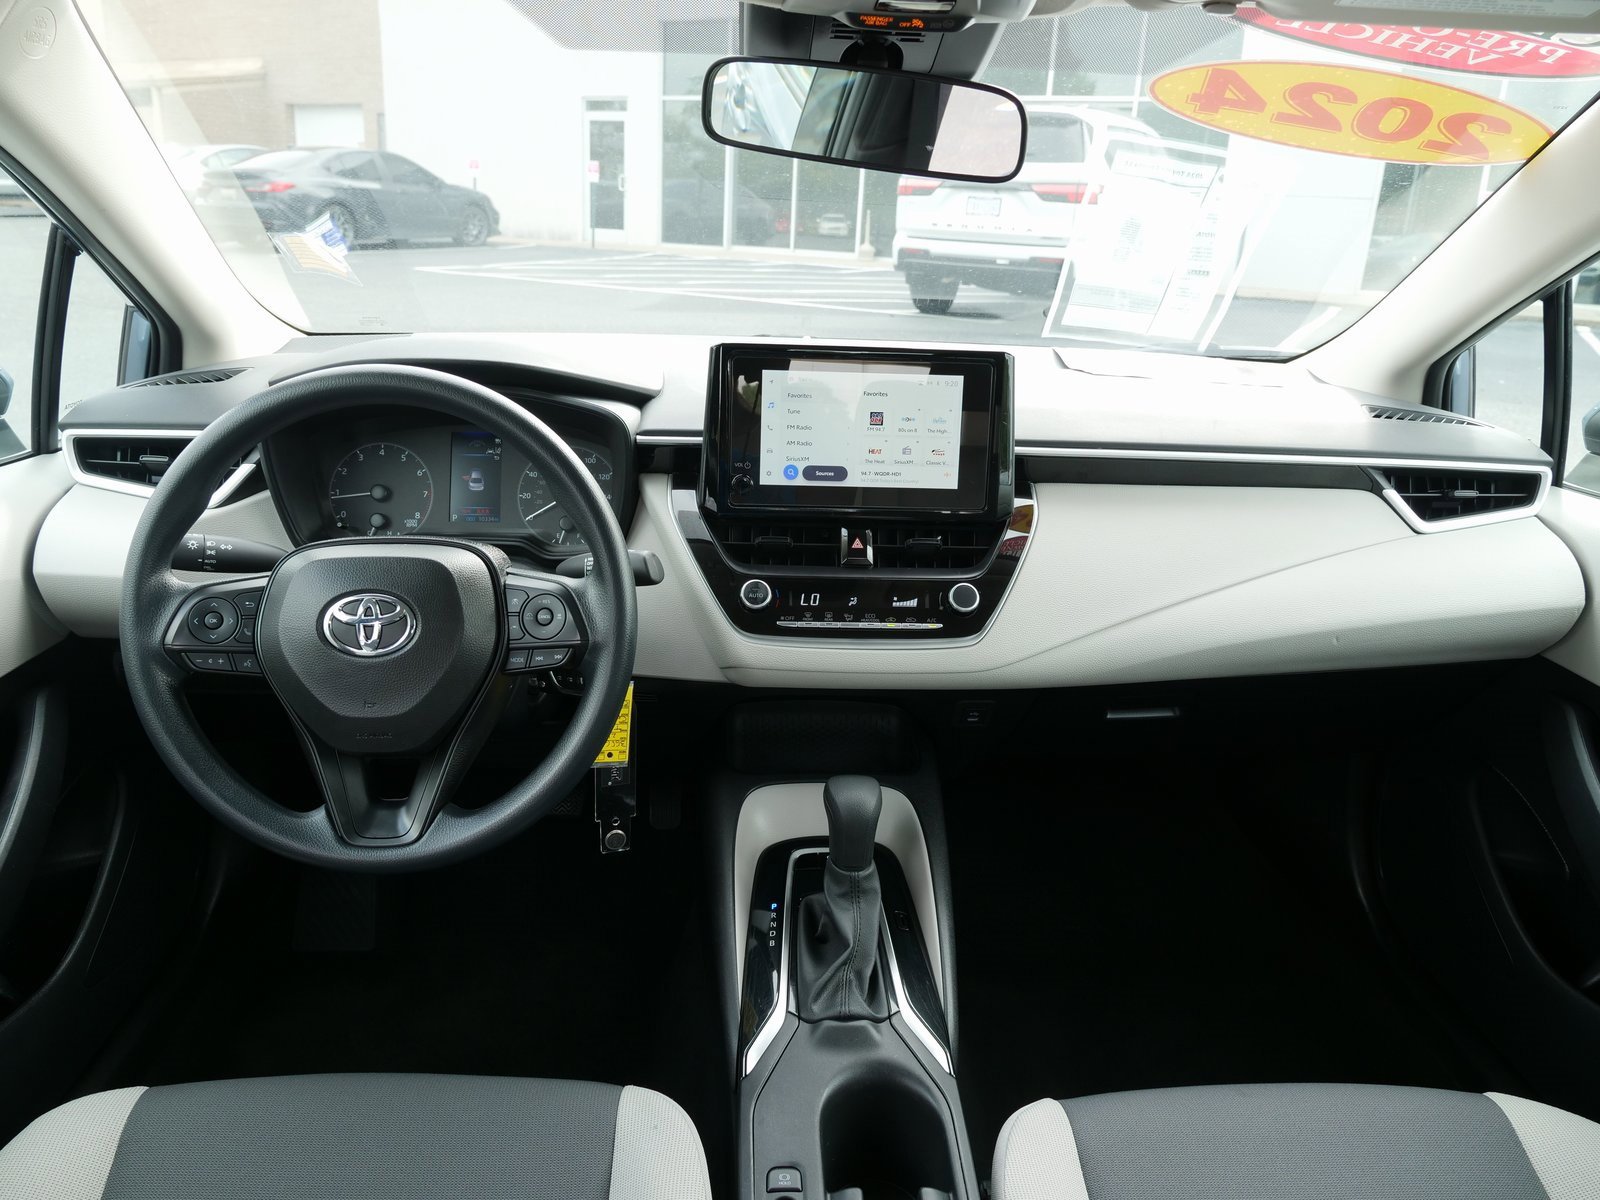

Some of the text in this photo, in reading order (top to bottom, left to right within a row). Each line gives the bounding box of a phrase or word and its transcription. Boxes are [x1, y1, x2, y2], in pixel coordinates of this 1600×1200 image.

[863, 390, 889, 398] Favorites
[423, 490, 428, 498] 7
[415, 511, 420, 519] 8
[452, 514, 458, 522] P
[800, 593, 820, 606] LO
